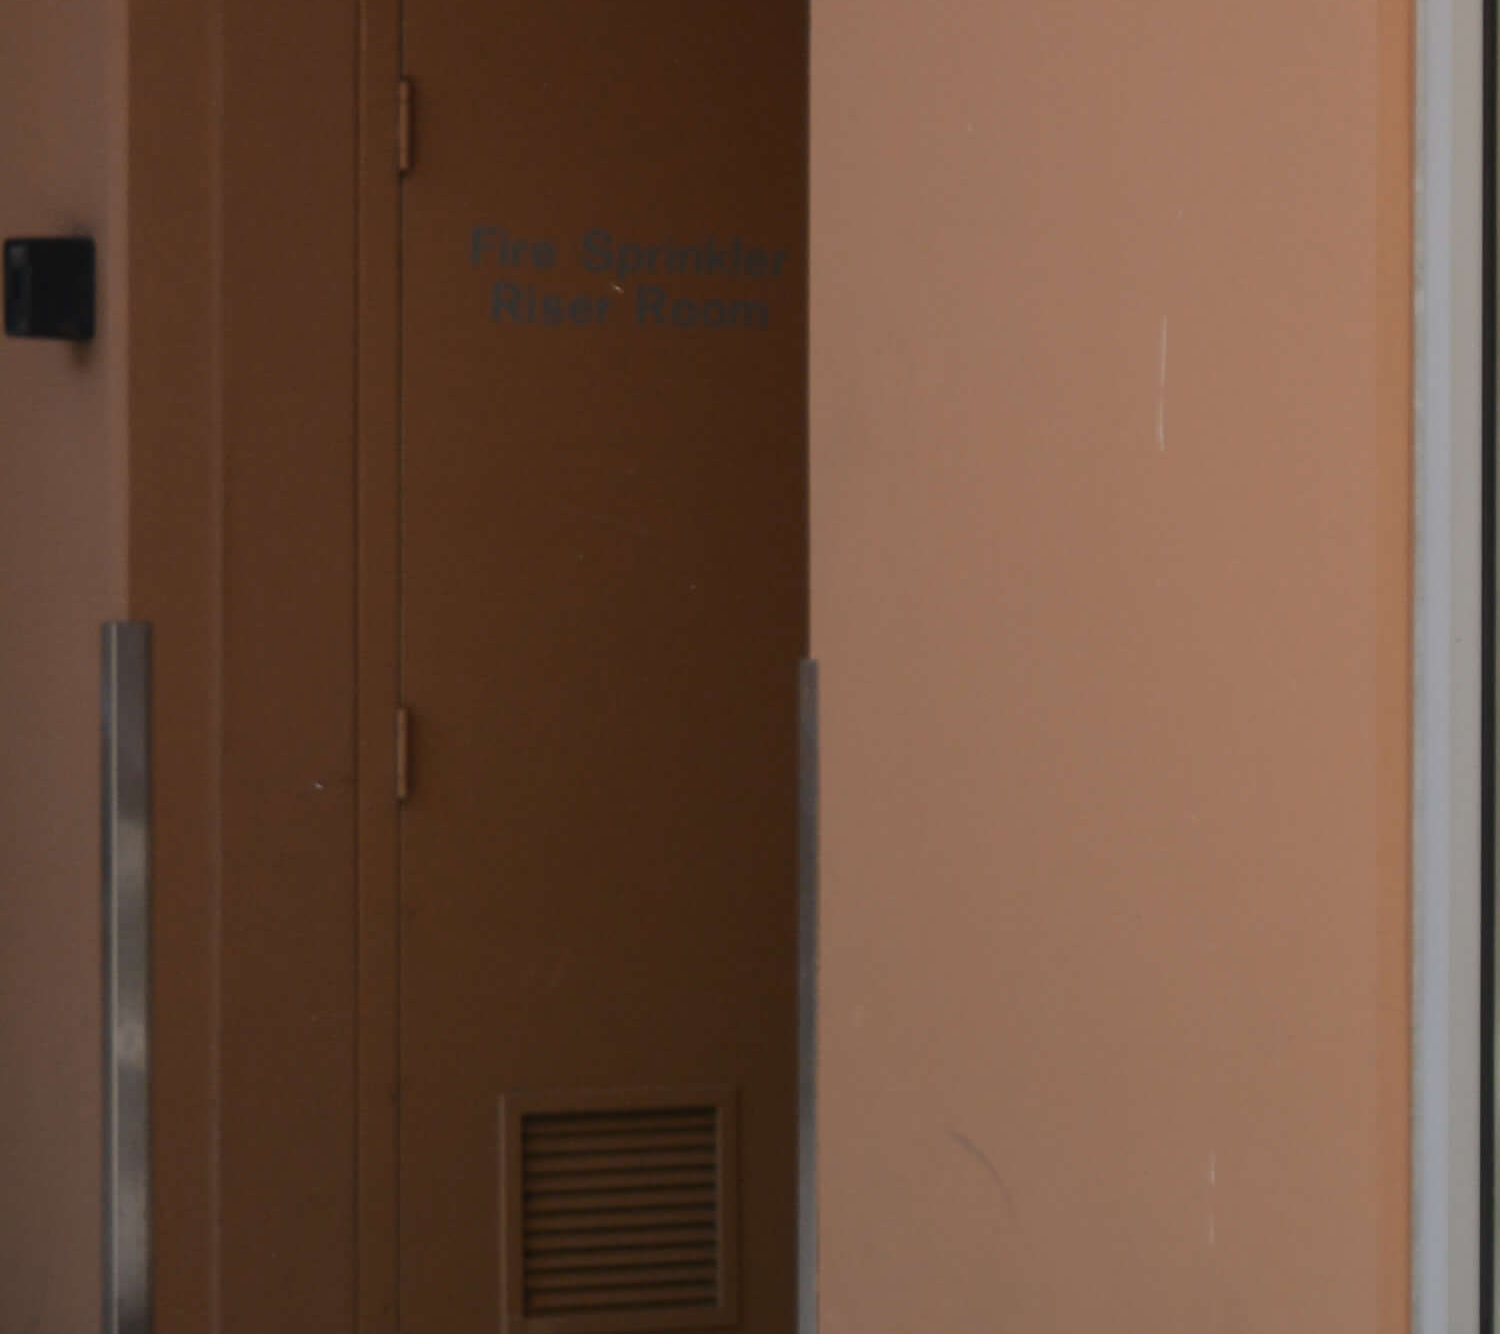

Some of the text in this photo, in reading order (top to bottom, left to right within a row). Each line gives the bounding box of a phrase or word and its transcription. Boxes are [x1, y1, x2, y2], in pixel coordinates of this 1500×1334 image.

[471, 224, 791, 279] Fire Sprinkler
[490, 281, 770, 330] Riser Room
